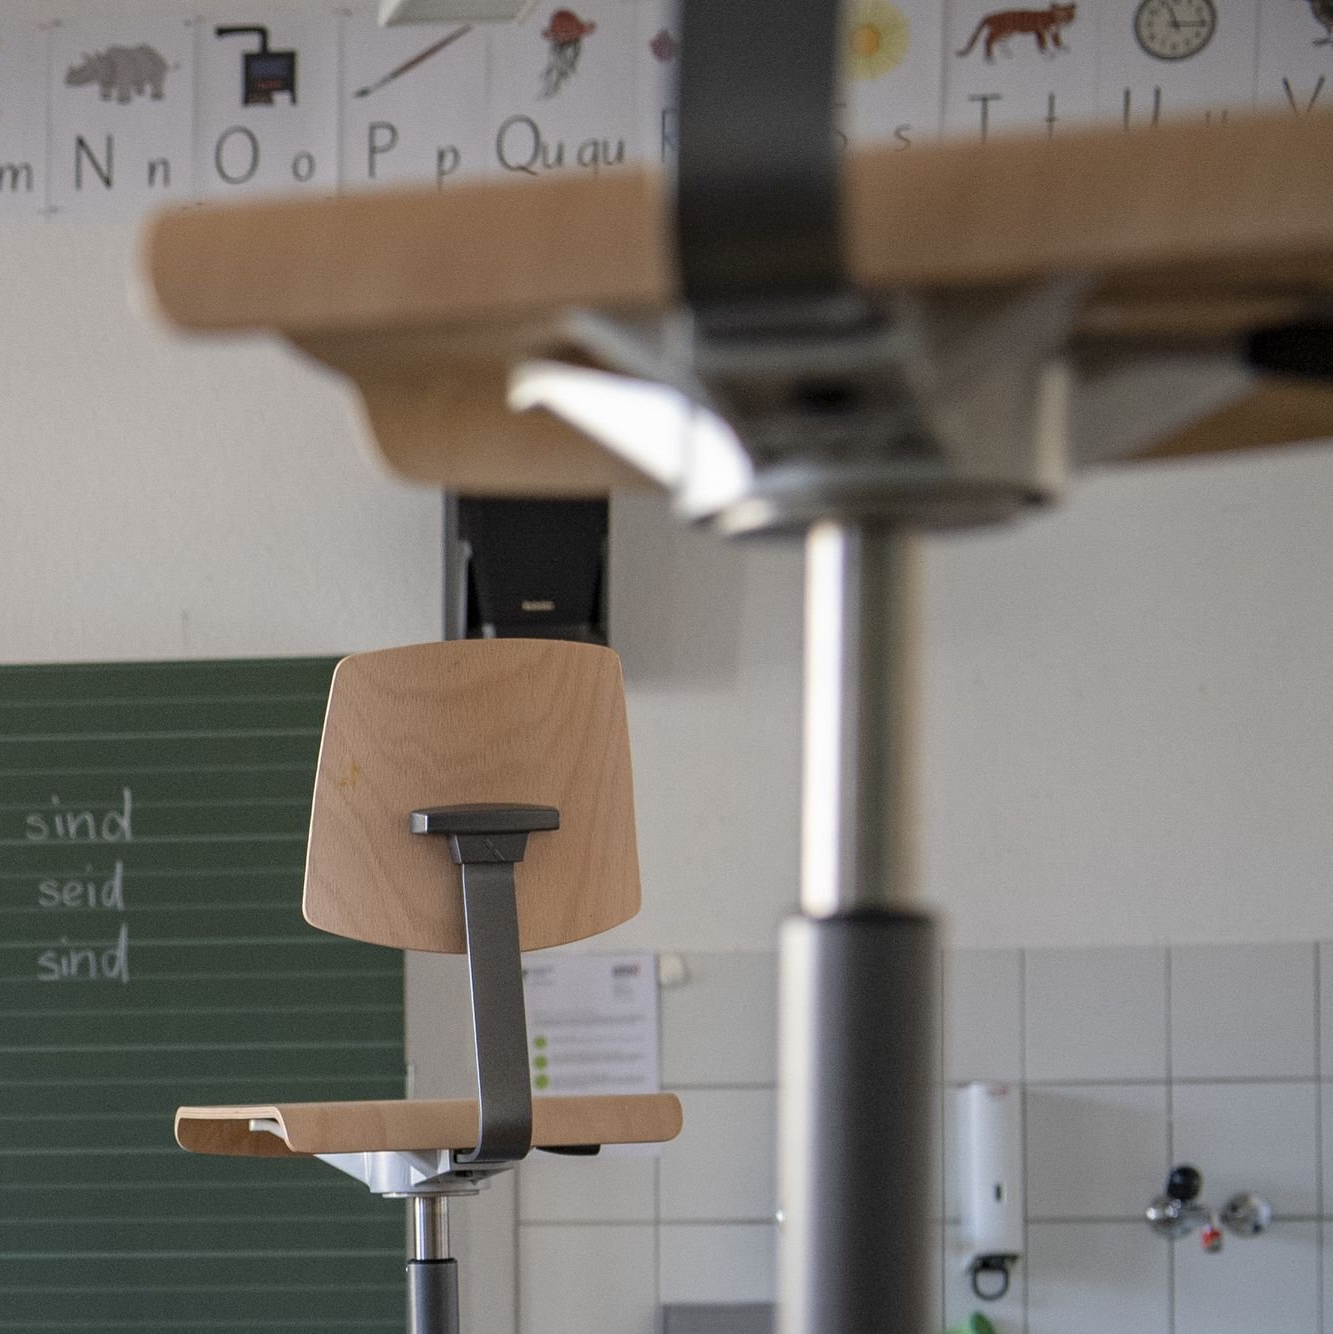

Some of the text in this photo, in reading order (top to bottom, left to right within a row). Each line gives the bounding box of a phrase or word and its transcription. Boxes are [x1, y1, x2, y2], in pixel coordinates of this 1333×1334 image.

[75, 134, 113, 190] N
[148, 157, 170, 187] n
[214, 127, 259, 184] O
[292, 151, 315, 182] o
[368, 122, 398, 178] P
[437, 145, 460, 190] p
[496, 115, 564, 175] Qu
[577, 135, 624, 178] qu
[968, 93, 1002, 145] T
[26, 786, 132, 843] sind
[38, 860, 124, 910] seid
[37, 923, 130, 984] sind
